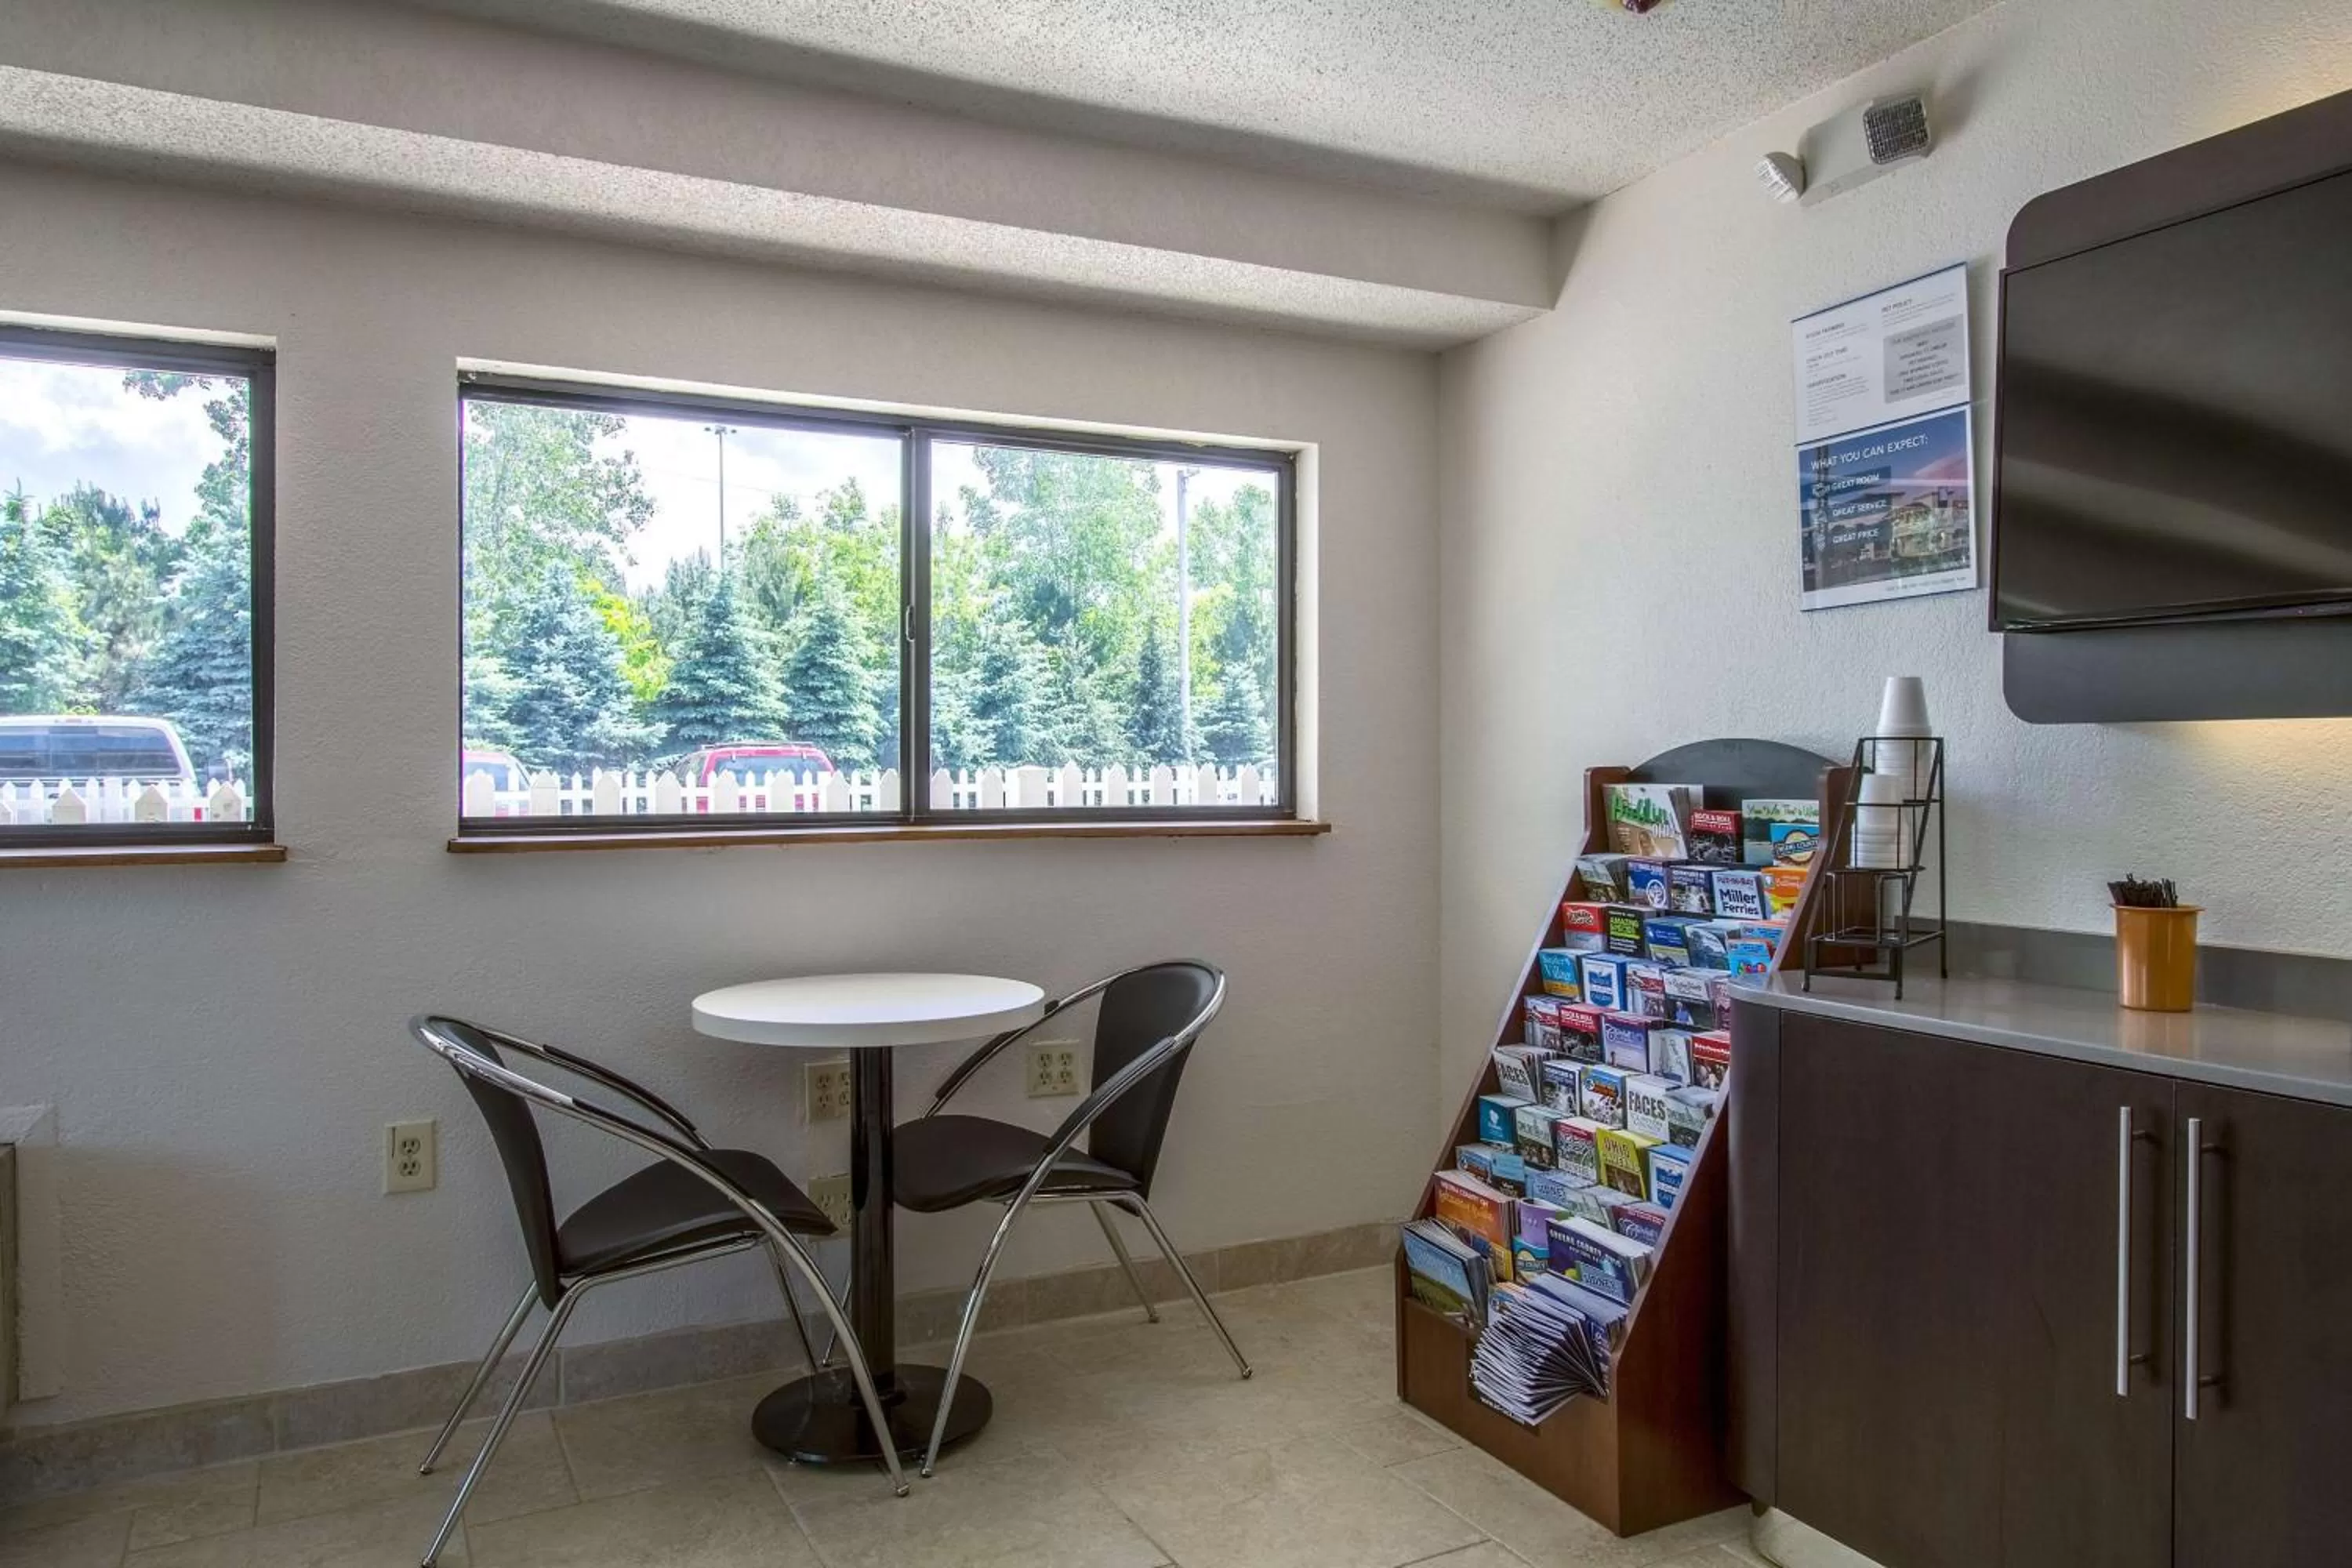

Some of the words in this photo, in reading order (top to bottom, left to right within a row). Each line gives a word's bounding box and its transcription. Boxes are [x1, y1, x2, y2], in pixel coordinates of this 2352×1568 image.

[1811, 456, 1838, 470] WHAT
[1840, 451, 1860, 463] YOU
[1863, 445, 1884, 459] CAN
[1887, 433, 1929, 452] EXPECT:
[1832, 505, 1856, 517] GREAT
[1857, 499, 1887, 512] SERVICE
[1832, 532, 1856, 543] GREAT
[1858, 528, 1879, 540] PRICE
[1719, 888, 1756, 904] Miller
[1722, 902, 1759, 915] Ferries
[1628, 1091, 1666, 1121] FACES
